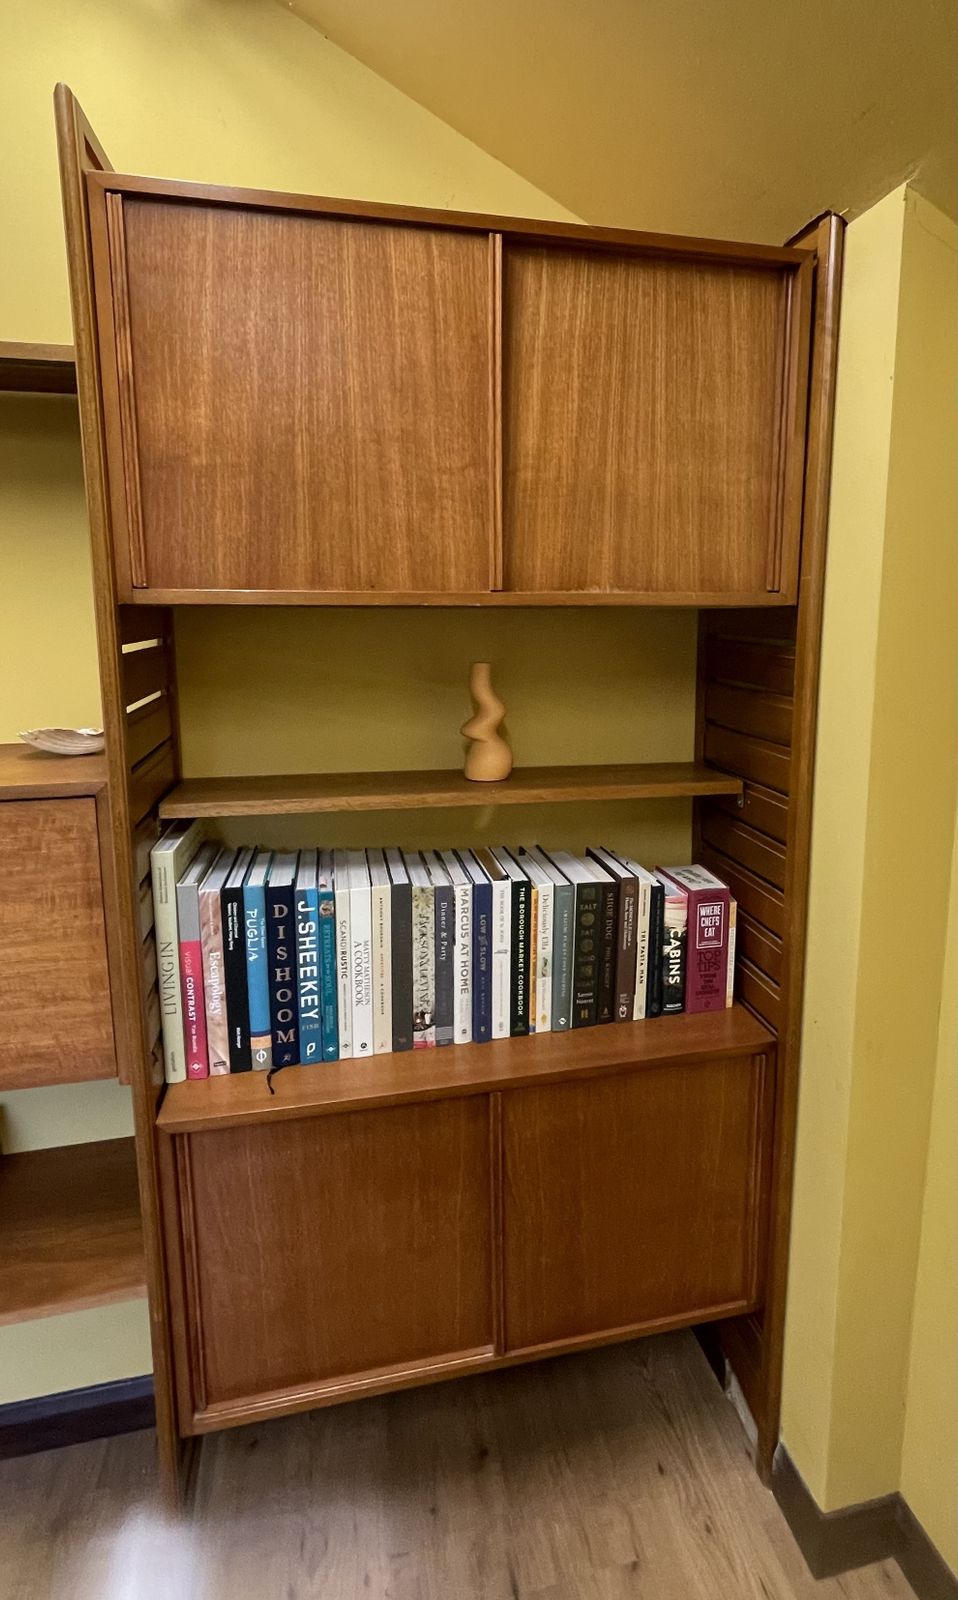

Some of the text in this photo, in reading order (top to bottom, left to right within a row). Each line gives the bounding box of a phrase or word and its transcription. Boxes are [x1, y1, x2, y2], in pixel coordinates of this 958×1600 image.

[440, 902, 448, 929] Dinner
[460, 888, 469, 940] MARCUS
[540, 894, 549, 935] Deliciously
[605, 919, 613, 940] DOG
[700, 905, 721, 916] WHERE
[701, 916, 720, 927] CHEFS
[246, 908, 258, 961] PUGLIA
[440, 941, 448, 961] Party
[461, 943, 469, 957] AT
[704, 927, 716, 938] EAT
[184, 952, 193, 976] visual
[273, 904, 295, 1044] DISHOOM
[297, 900, 319, 1019] J.SHEEKEY
[669, 928, 681, 984] CABINS
[160, 941, 176, 1015] LIVING IN
[208, 951, 222, 1015] Escapology
[354, 950, 363, 1007] COOKBOOK
[460, 960, 470, 995] HOME
[186, 977, 196, 1022] CONTRAST
